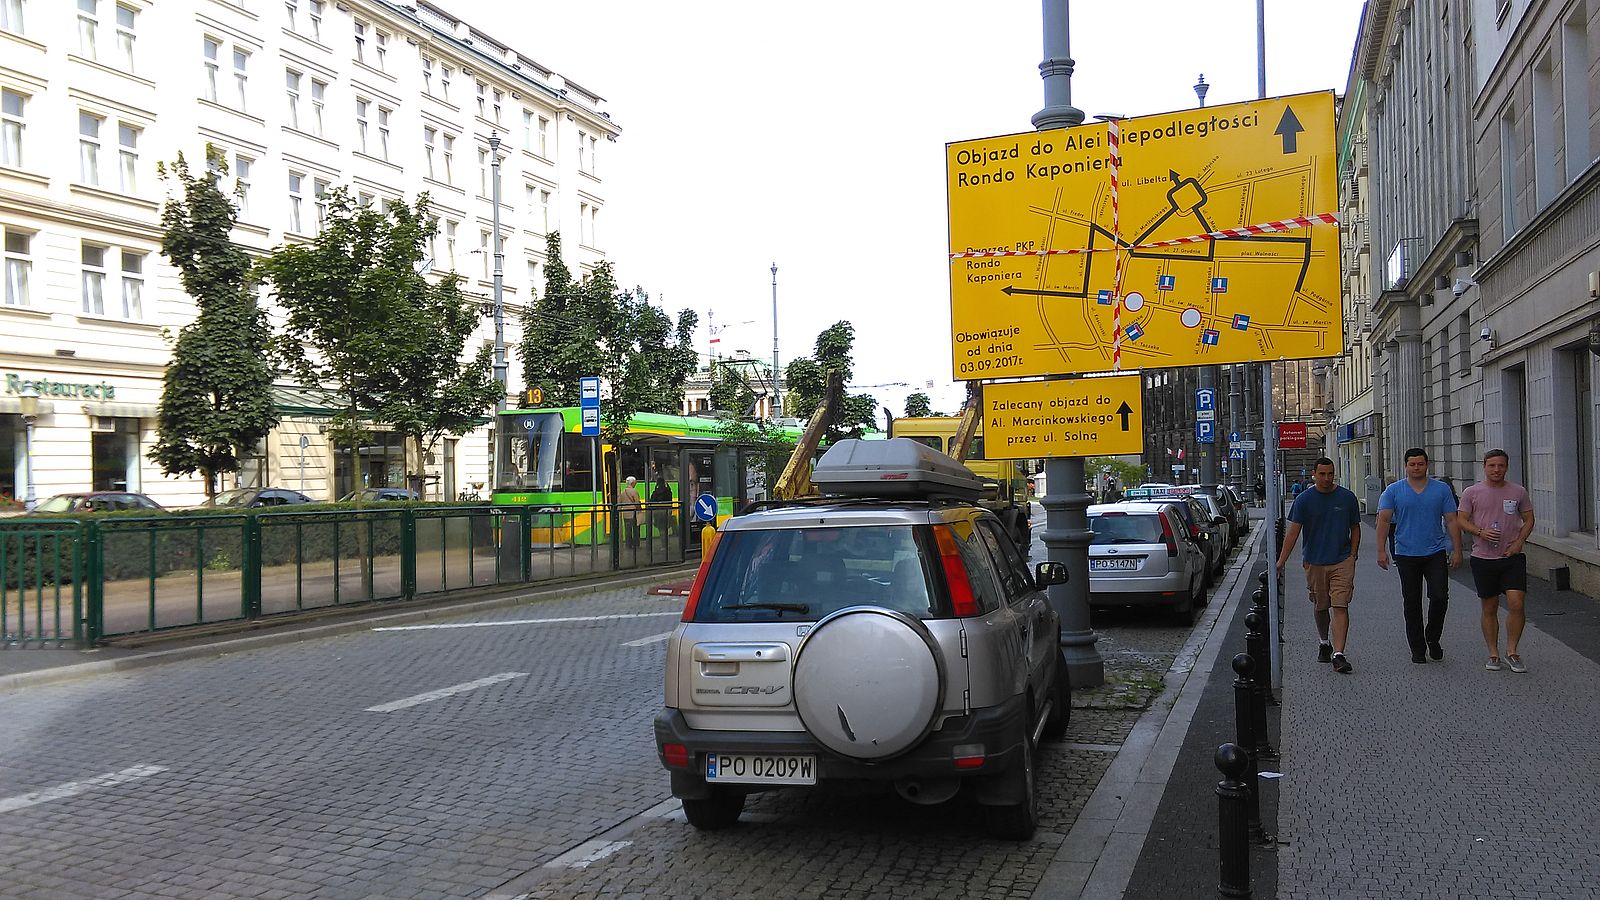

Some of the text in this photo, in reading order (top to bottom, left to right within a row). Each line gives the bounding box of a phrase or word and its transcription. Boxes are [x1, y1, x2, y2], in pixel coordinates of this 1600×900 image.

[956, 144, 1019, 166] Objazd
[1031, 140, 1053, 156] do
[1065, 132, 1100, 151] Alei
[958, 168, 1015, 187] Rondo
[1137, 176, 1167, 186] Libelta
[1016, 240, 1034, 252] PKP
[966, 258, 1000, 270] Rondo
[967, 271, 1022, 284] Kaponiera
[956, 325, 1020, 342] Obowiązuje
[967, 342, 1012, 356] od dnia
[527, 389, 542, 404] 13
[992, 394, 1110, 411] Zalecany objazd do
[992, 412, 1114, 428] Al. Marcinkowskiego
[1007, 430, 1098, 446] przez ul. Solną
[1096, 560, 1136, 568] PO 5147N
[724, 686, 784, 695] CR-V
[720, 756, 812, 778] PO 0209W
